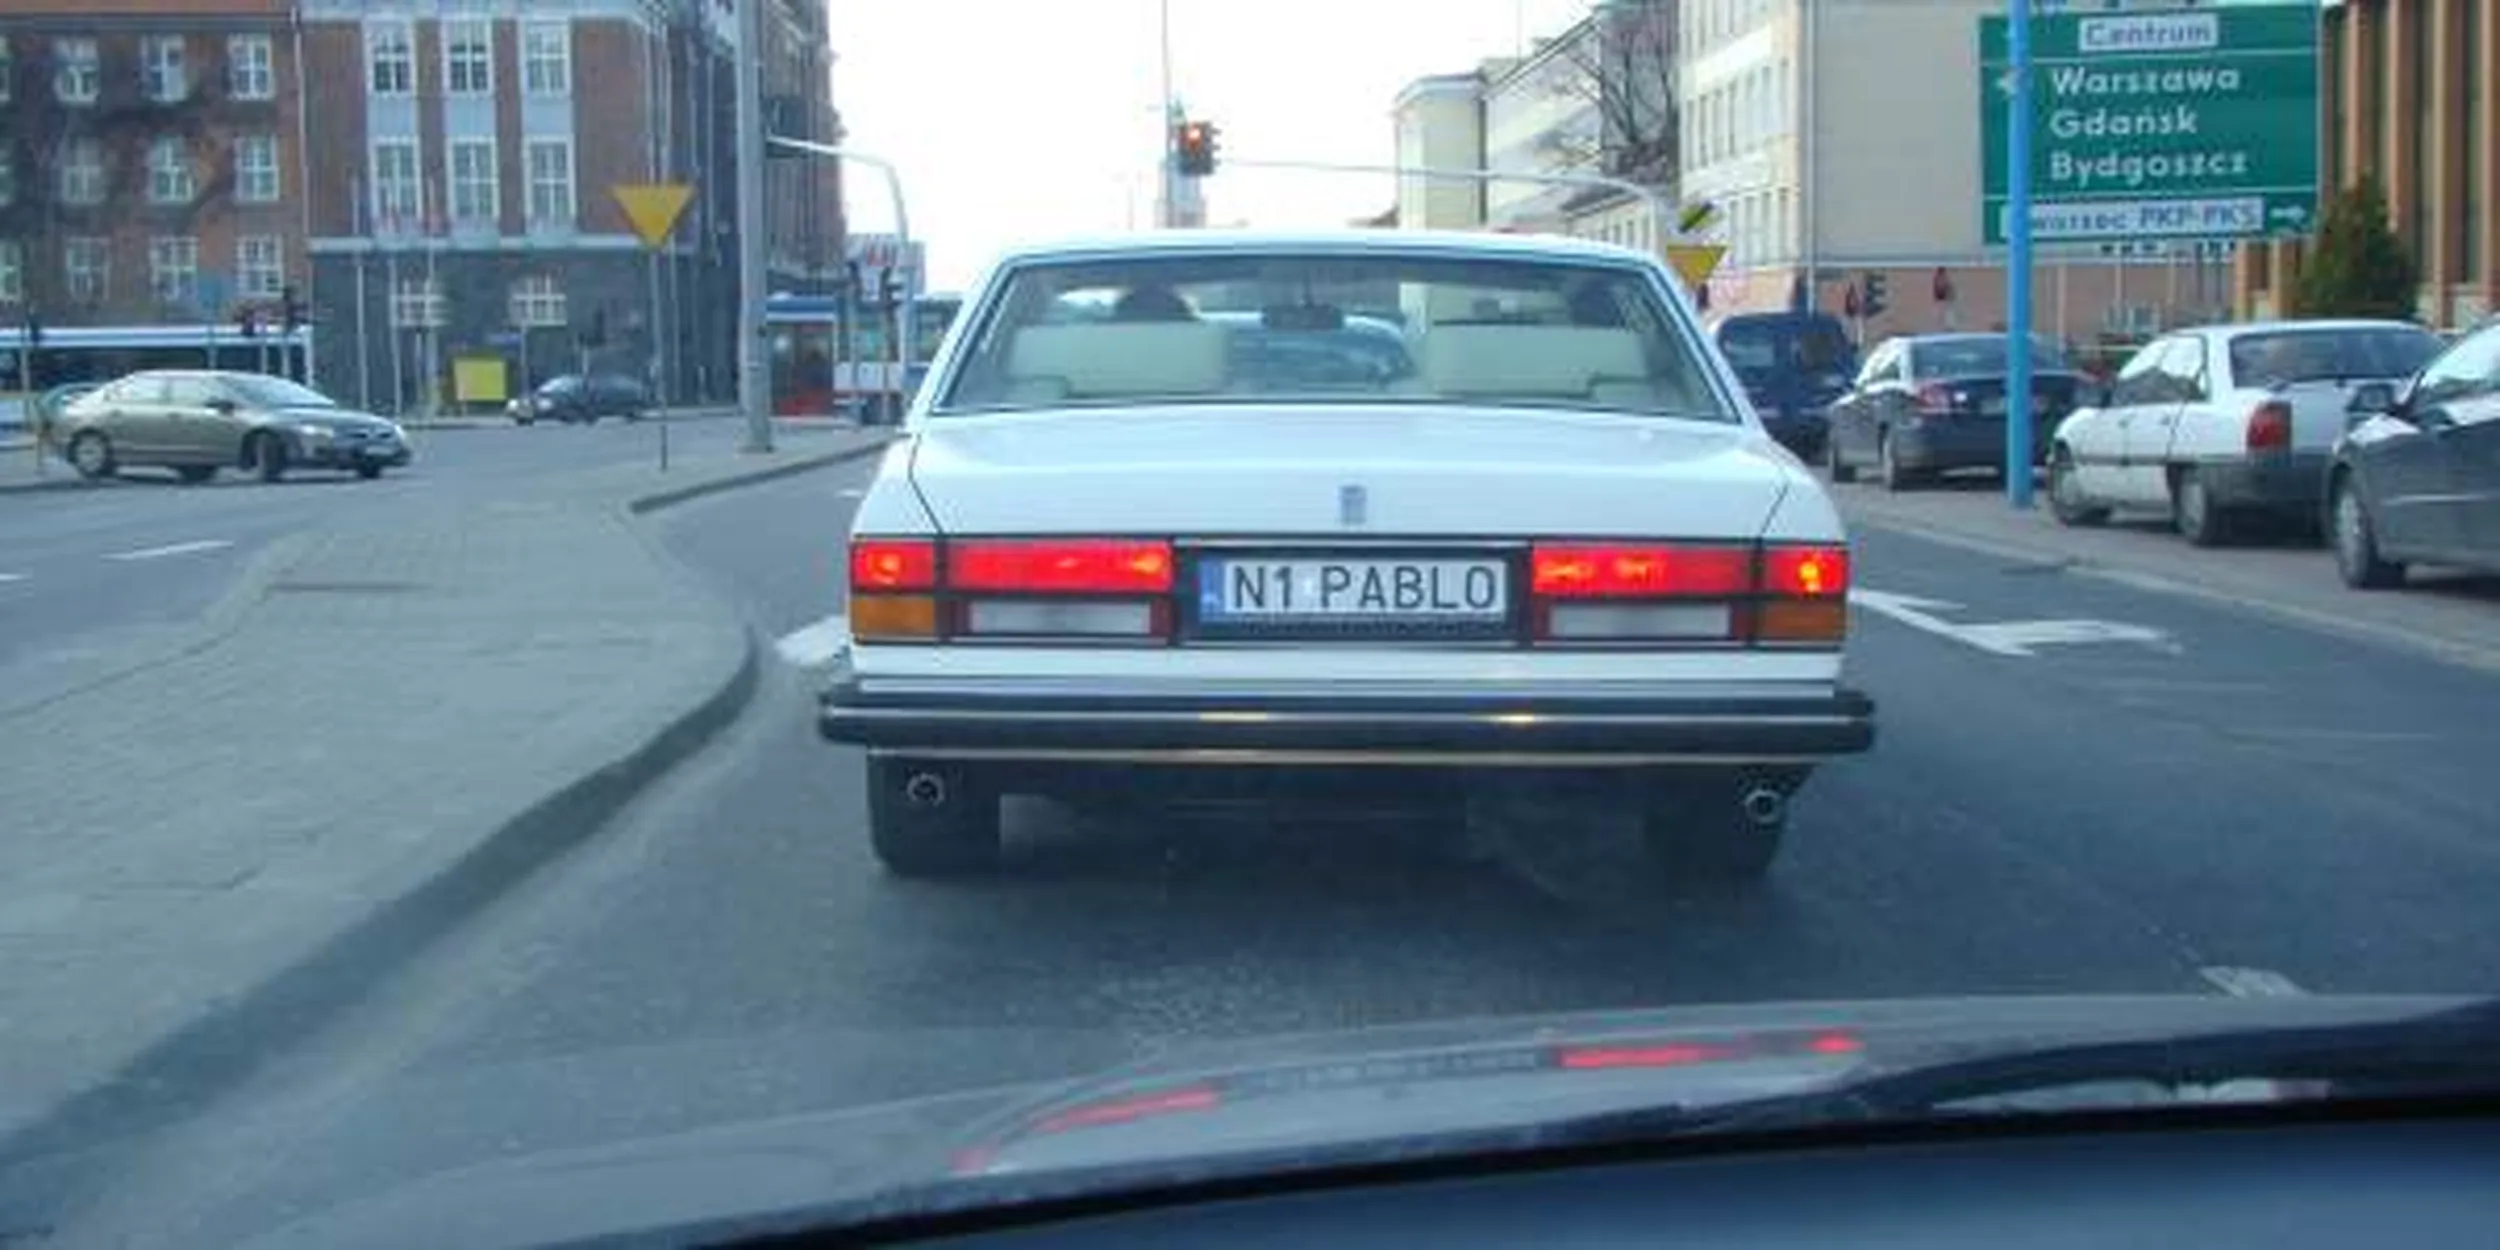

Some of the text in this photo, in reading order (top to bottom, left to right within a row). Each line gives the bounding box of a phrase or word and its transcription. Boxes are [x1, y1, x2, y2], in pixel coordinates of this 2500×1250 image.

[2086, 20, 2211, 46] Centrum
[2052, 66, 2240, 96] Warszawa
[2050, 105, 2198, 139] Gdańsk
[2049, 149, 2248, 187] Bydgoszcz
[1234, 565, 1293, 609] N1
[1320, 565, 1497, 610] PABLO
